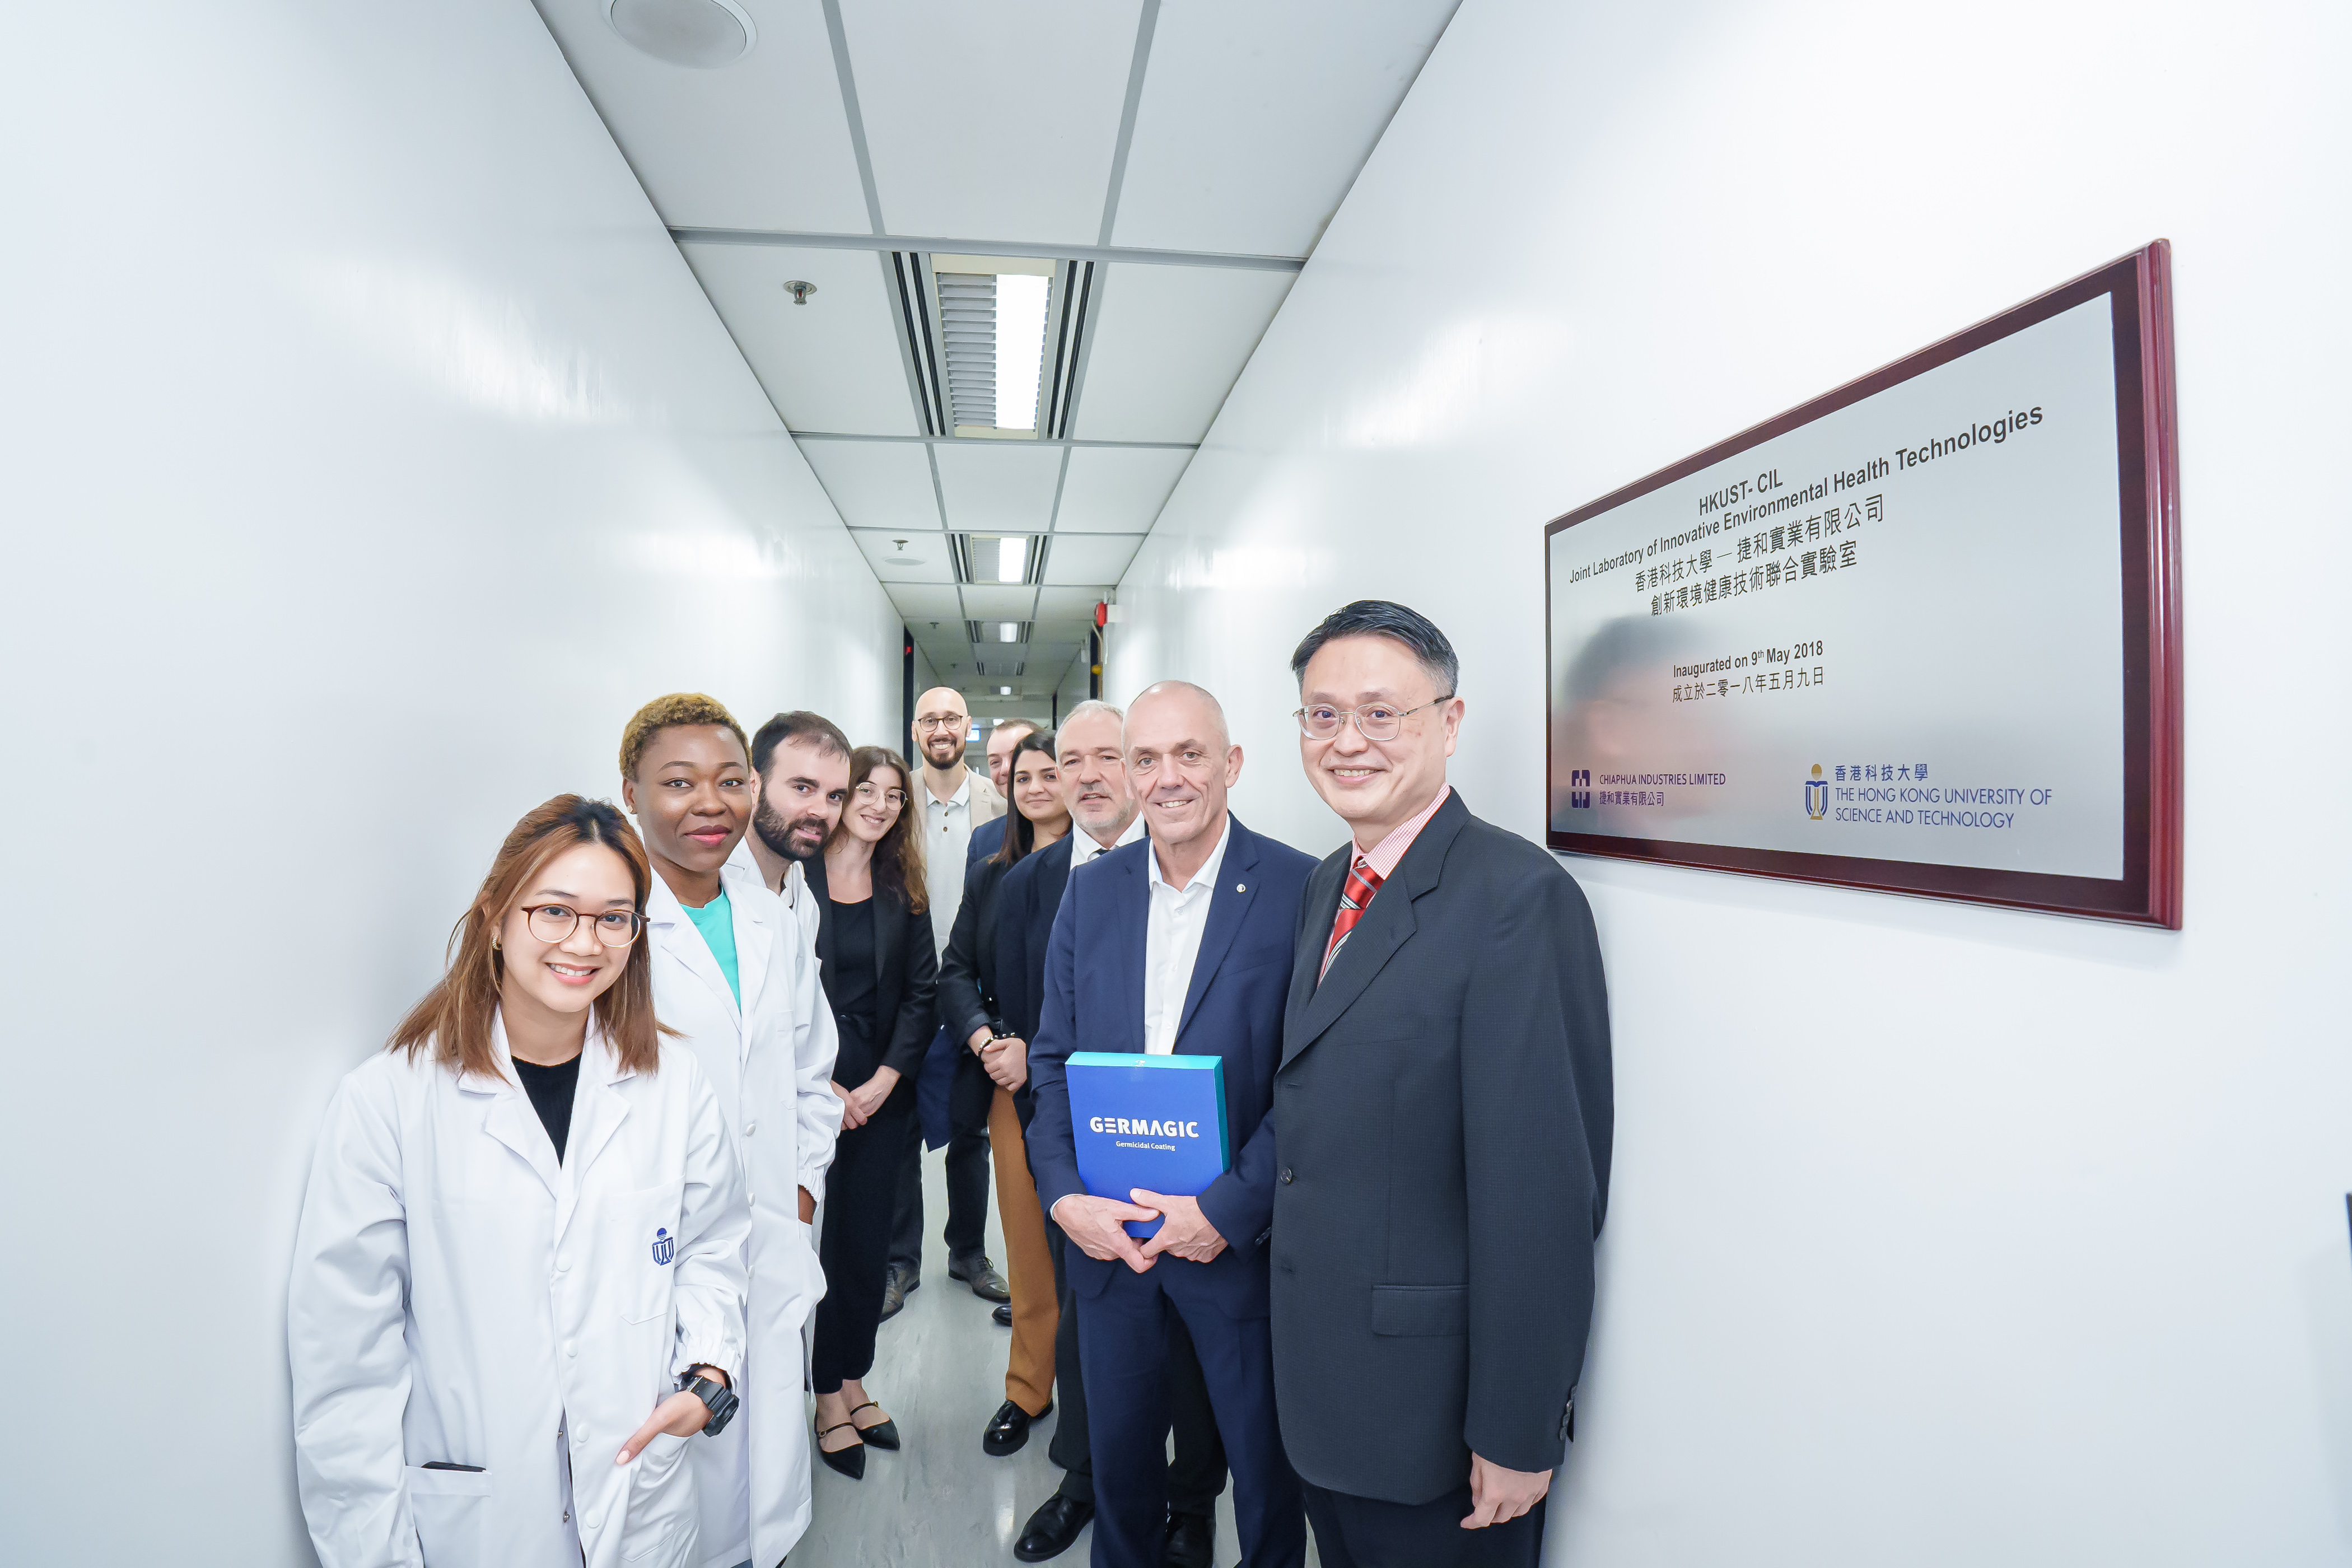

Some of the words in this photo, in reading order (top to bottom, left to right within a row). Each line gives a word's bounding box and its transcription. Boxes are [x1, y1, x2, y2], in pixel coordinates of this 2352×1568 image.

[1757, 469, 1783, 493] CIL
[1570, 564, 1591, 584] Joint
[1593, 548, 1644, 576] Laboratory
[1647, 539, 1658, 557] of
[1660, 521, 1720, 553] Innovative
[1724, 477, 1828, 531] Environmental
[1834, 457, 1889, 493] Health
[1895, 406, 2043, 470] Technologies
[1651, 540, 1857, 617] 創新環境健康技術聯合實驗室
[1673, 655, 1732, 678] Inaugurated
[1734, 656, 1748, 669] on
[1766, 647, 1790, 665] May
[1794, 640, 1823, 660] 2018
[1672, 666, 1823, 703] 成立於二零一八年五月九日
[1599, 774, 1637, 785] CHIAPHUA
[1639, 773, 1687, 785] INDUSTRIES
[1689, 773, 1726, 785] LIMITED
[1835, 787, 1854, 801] THE
[1858, 787, 1896, 802] HONG
[1900, 788, 1940, 803] KONG
[1945, 788, 2025, 805] UNIVERSITY
[2030, 788, 2052, 805] OF
[1835, 808, 1882, 823] SCIENCE
[1885, 809, 1914, 824] AND
[1917, 810, 2014, 829] TECHNOLOGY
[1090, 1117, 1200, 1138] GERMAGIC
[1116, 1141, 1150, 1149] Germicidal
[1151, 1142, 1175, 1151] Coating
